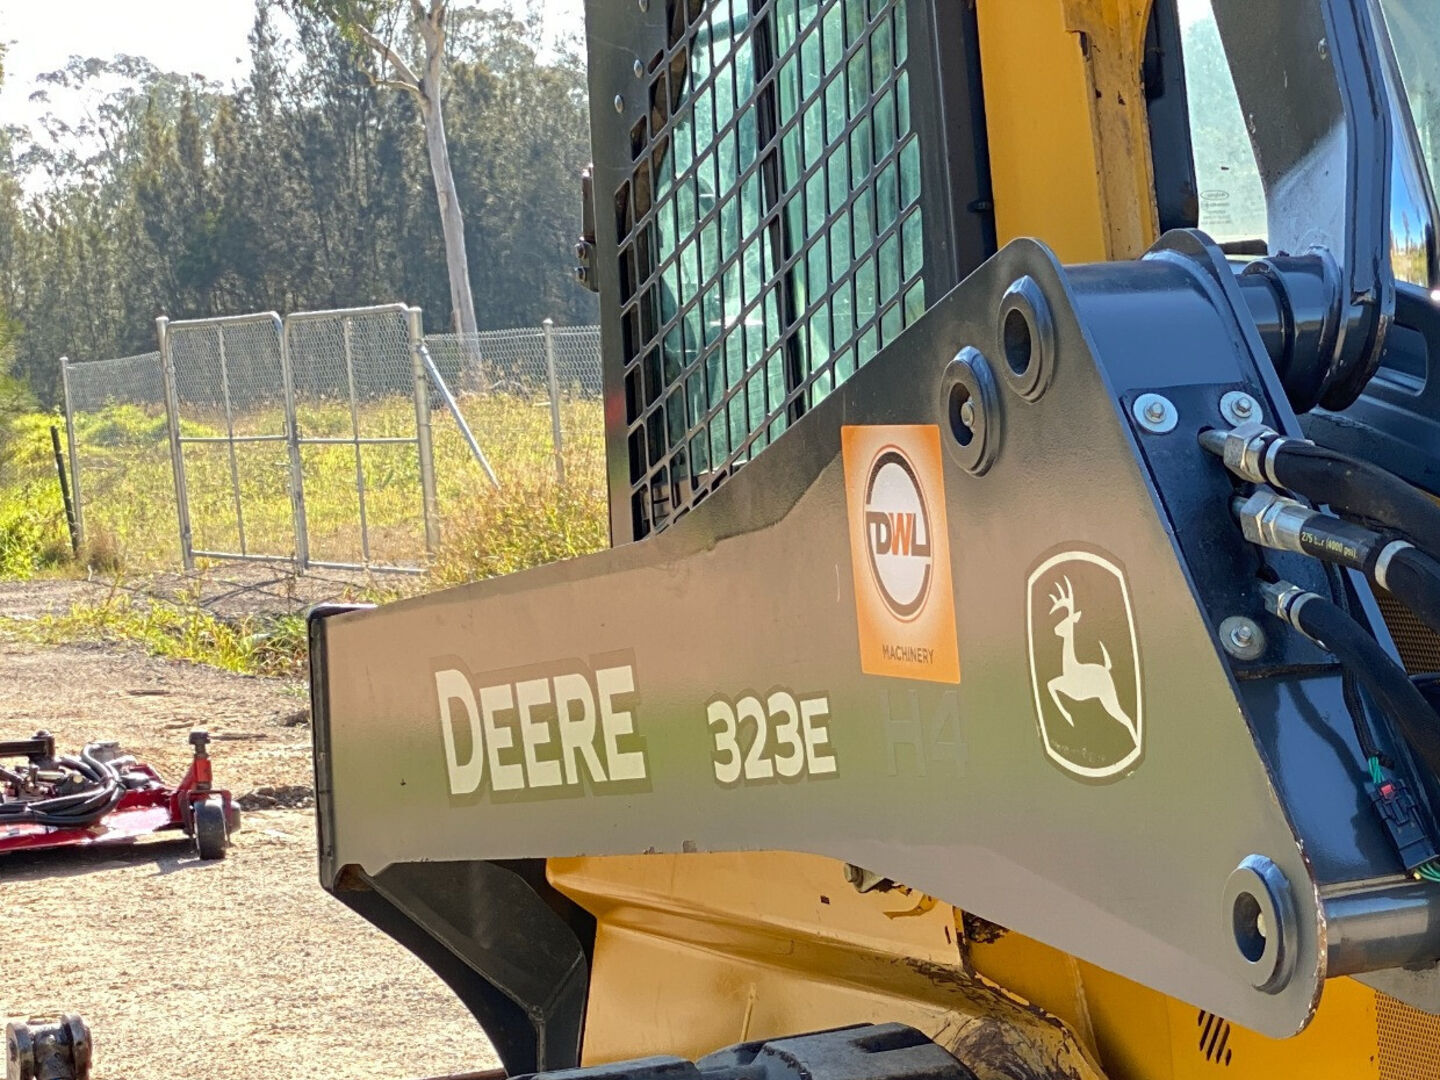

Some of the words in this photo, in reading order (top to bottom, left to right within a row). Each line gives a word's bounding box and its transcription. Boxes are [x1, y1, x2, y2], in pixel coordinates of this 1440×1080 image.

[866, 511, 931, 557] DWL
[882, 644, 934, 664] MACHINERY
[435, 665, 646, 795] DEERE
[707, 692, 837, 783] 323E
